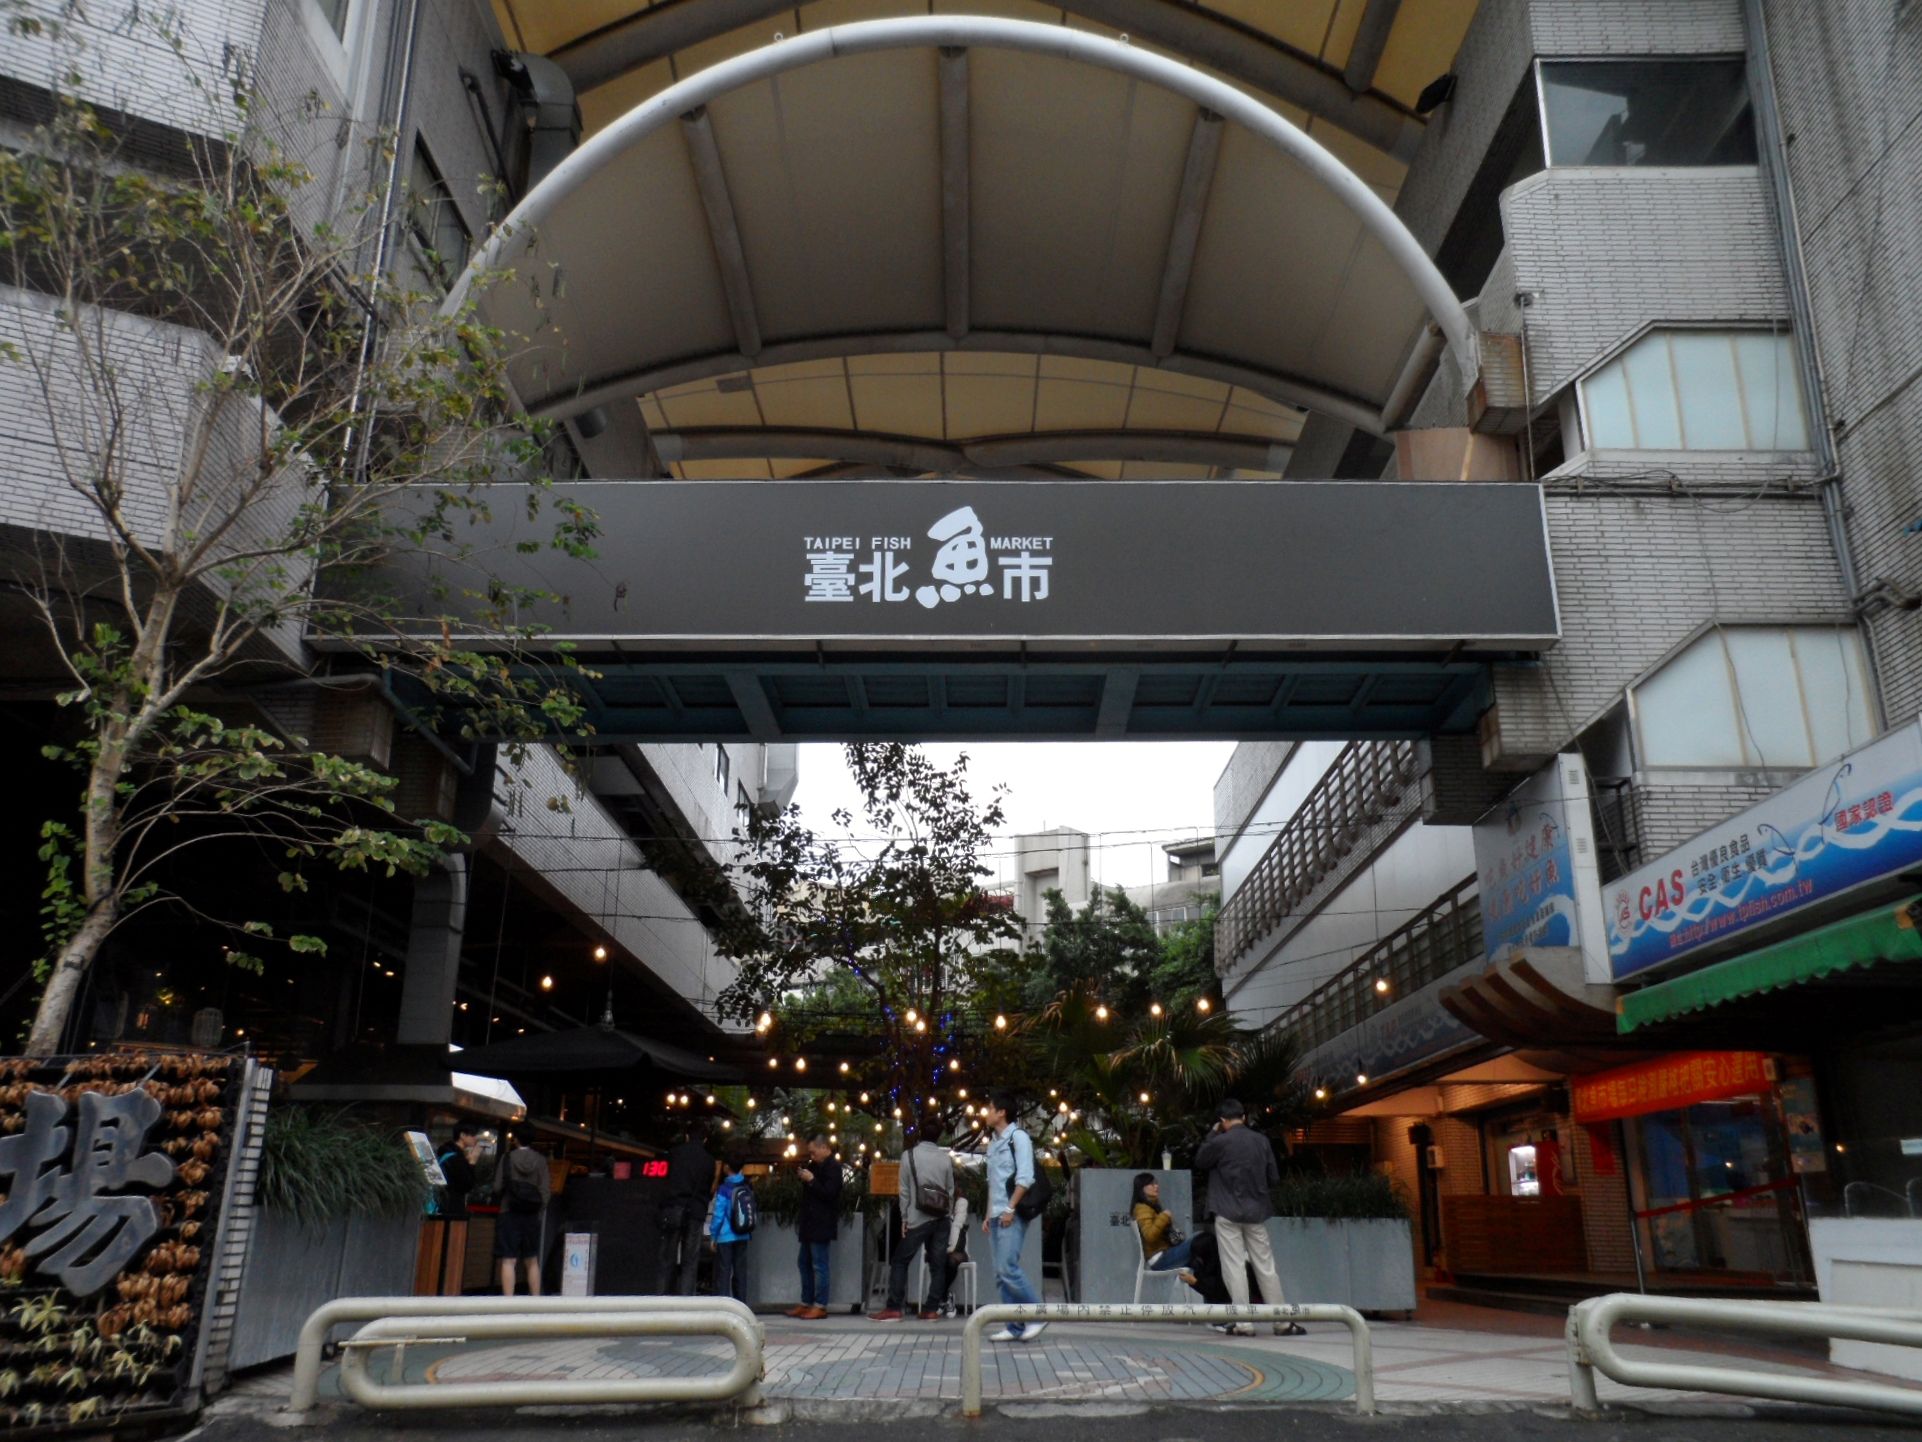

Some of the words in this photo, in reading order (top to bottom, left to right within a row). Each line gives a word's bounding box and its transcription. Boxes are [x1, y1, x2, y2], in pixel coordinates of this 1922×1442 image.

[804, 537, 860, 549] TAIPEI
[871, 537, 911, 549] FISH
[990, 537, 1053, 549] MARKET
[1639, 869, 1685, 920] CAS
[643, 1161, 667, 1177] 130
